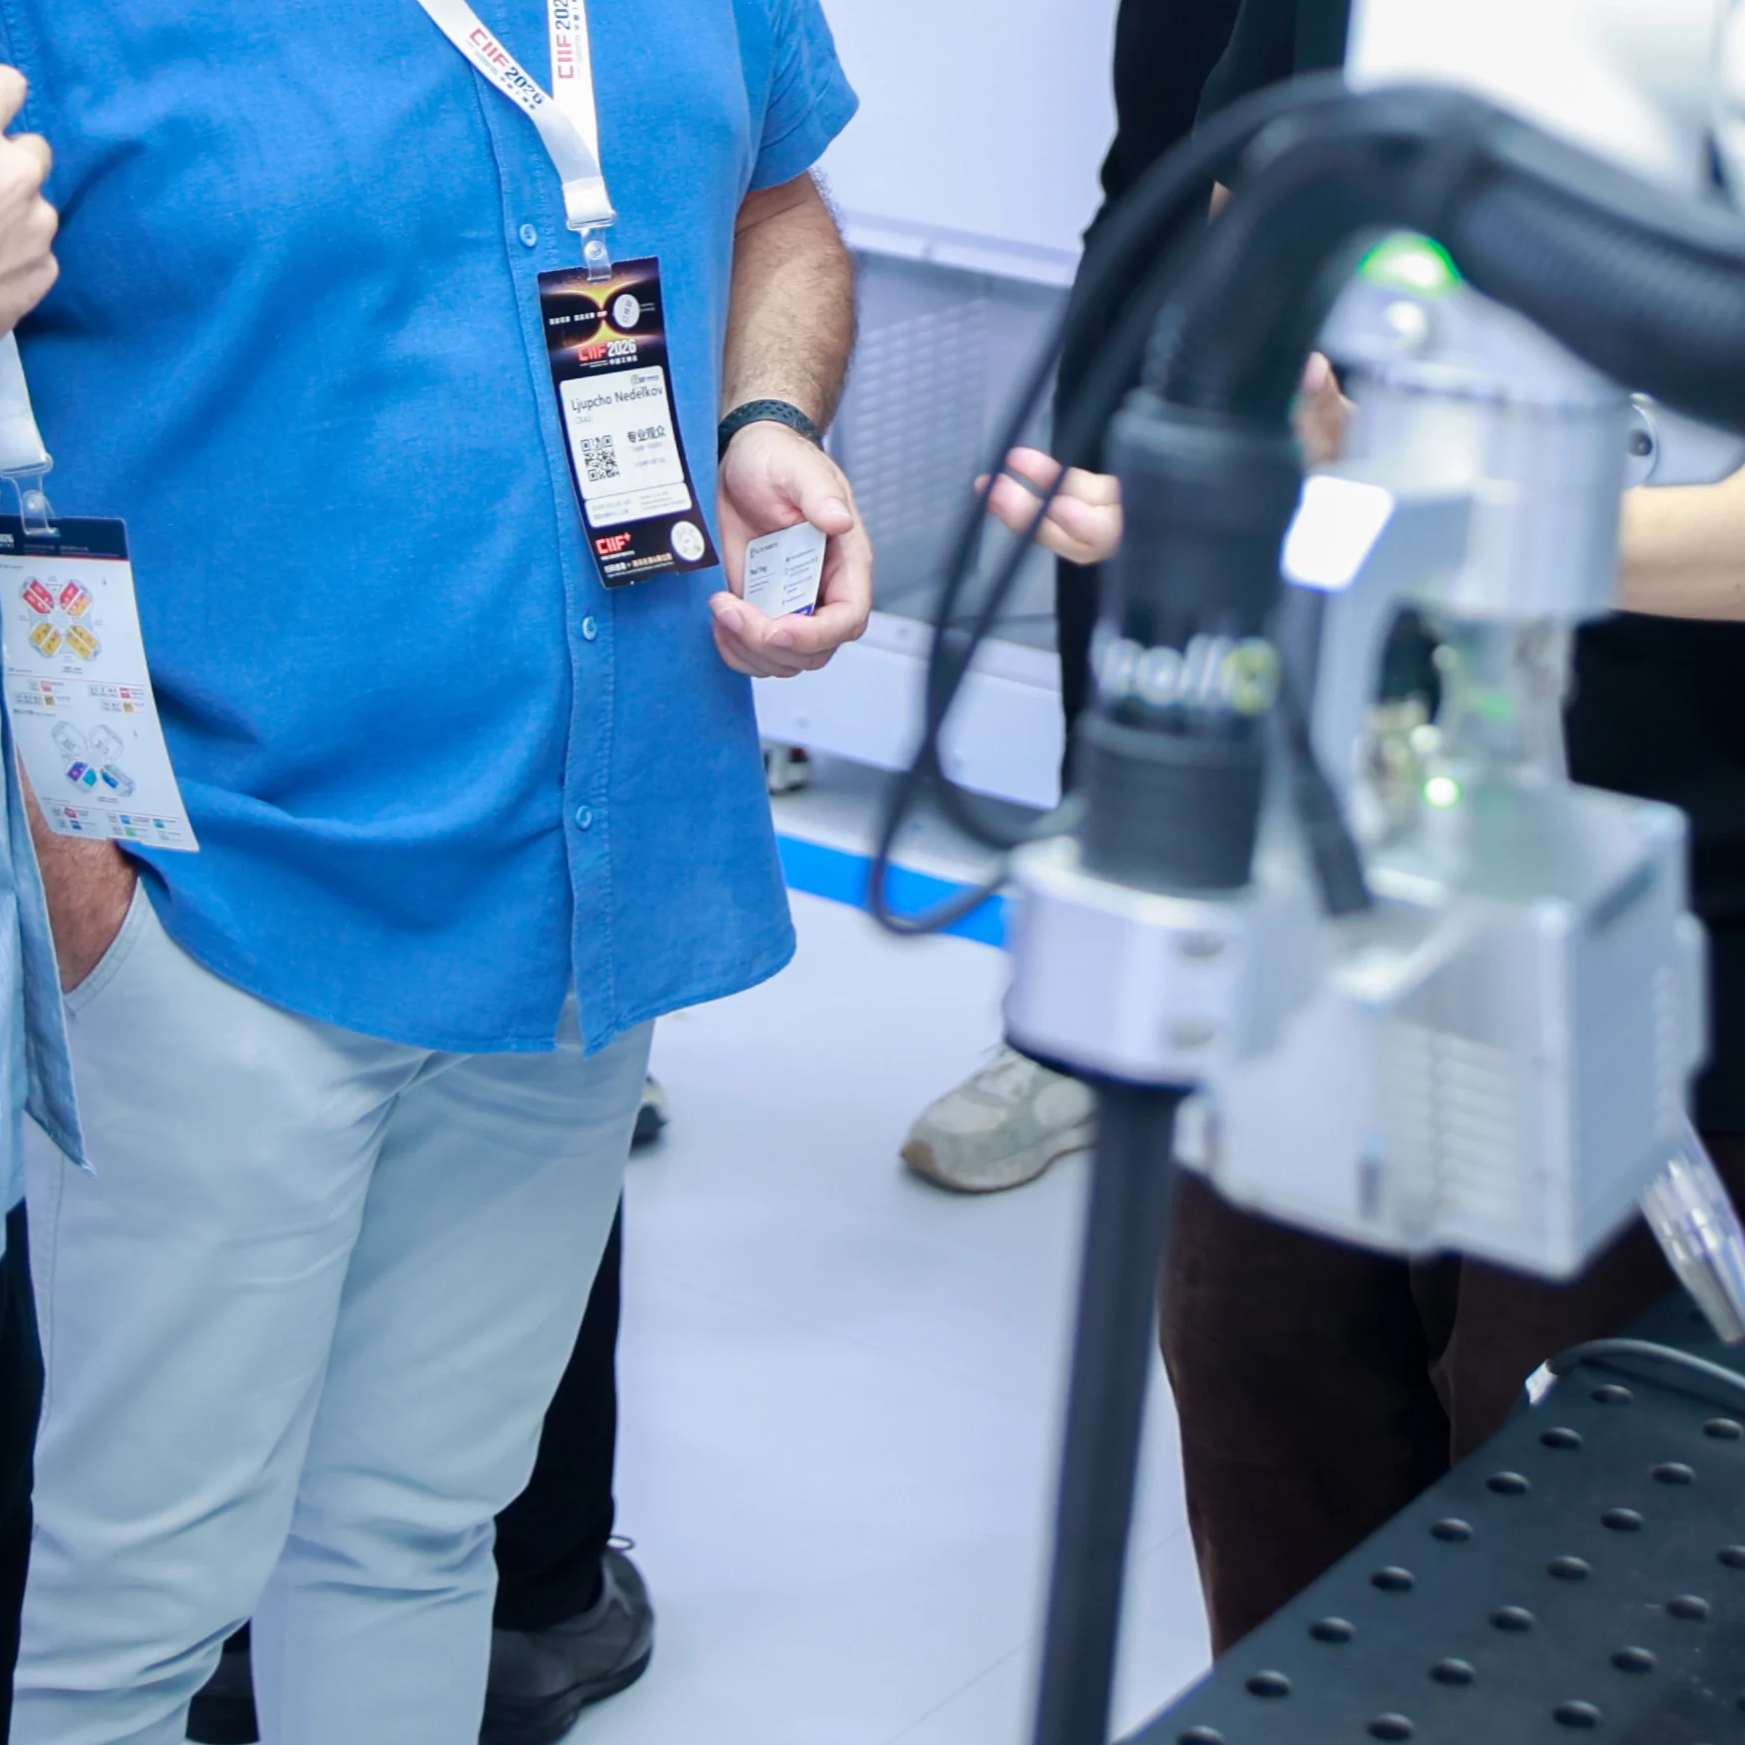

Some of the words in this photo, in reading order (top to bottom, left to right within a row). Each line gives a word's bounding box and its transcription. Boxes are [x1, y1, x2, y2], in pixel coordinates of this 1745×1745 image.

[470, 28, 509, 67] CIIF
[505, 67, 543, 104] 2026
[556, 34, 574, 79] CIIF
[577, 343, 607, 362] CIIF
[606, 338, 638, 357] 2026
[571, 393, 612, 413] Ljupcho
